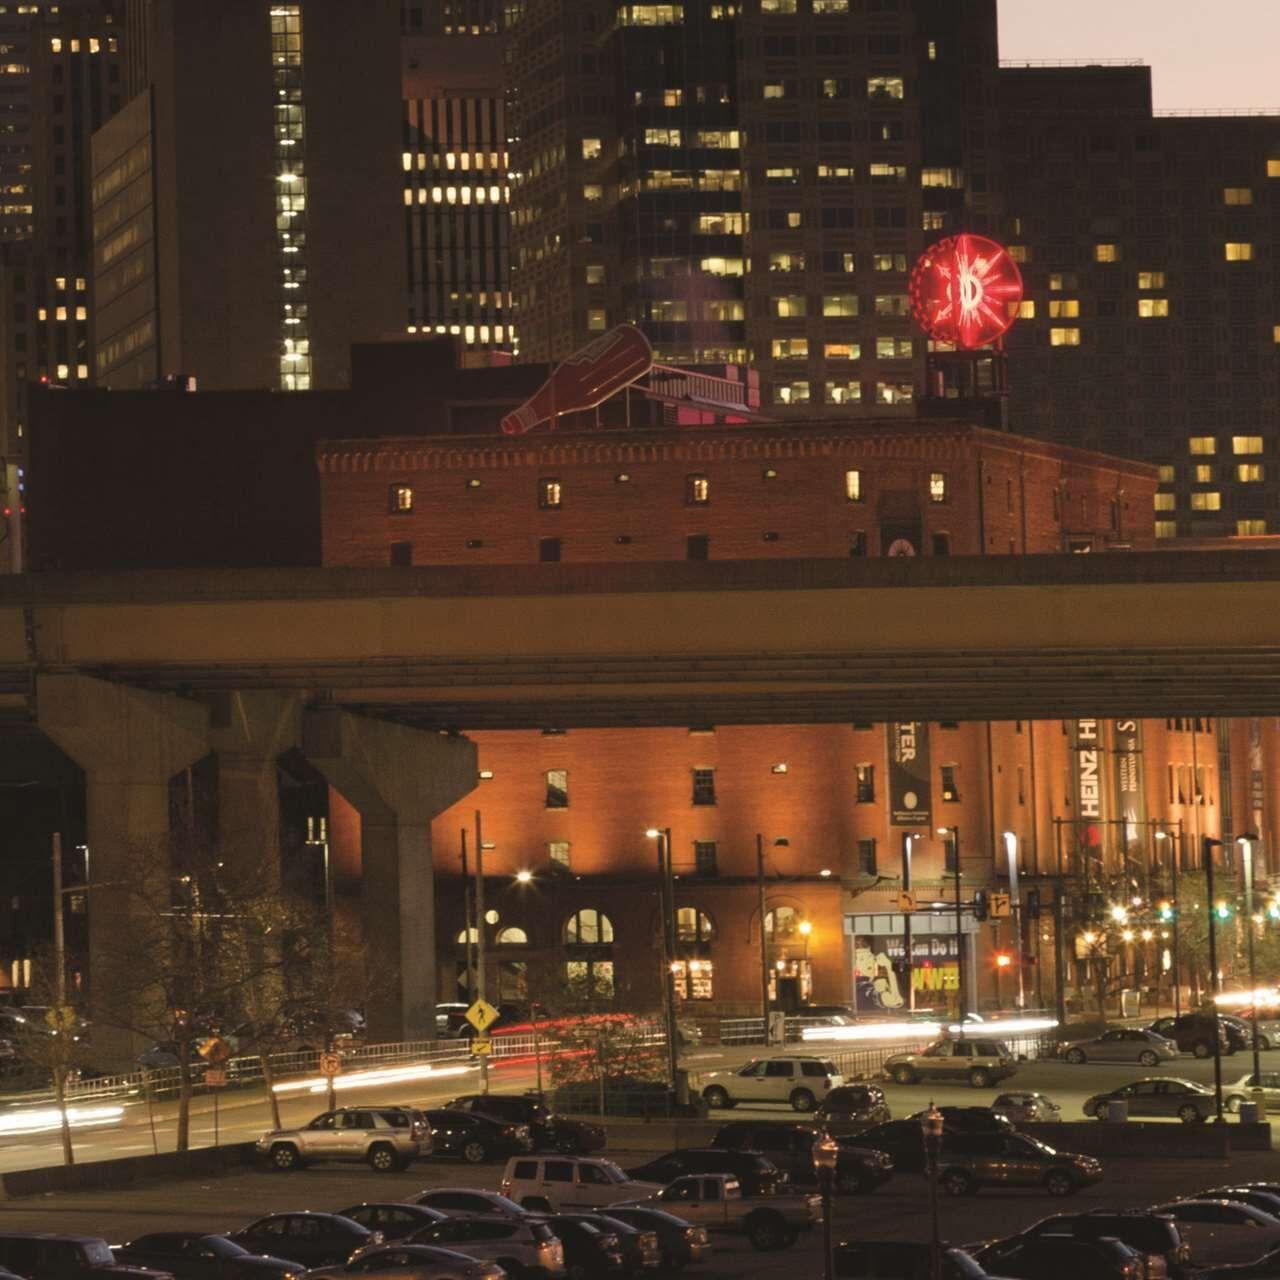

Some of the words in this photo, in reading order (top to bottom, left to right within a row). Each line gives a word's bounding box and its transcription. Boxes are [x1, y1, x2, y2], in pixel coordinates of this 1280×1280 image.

[1080, 746, 1100, 817] HEINZ
[1120, 757, 1129, 792] WESTERN
[1128, 738, 1137, 792] PENNSYLVNIA
[887, 939, 905, 956] We
[931, 938, 947, 956] Do
